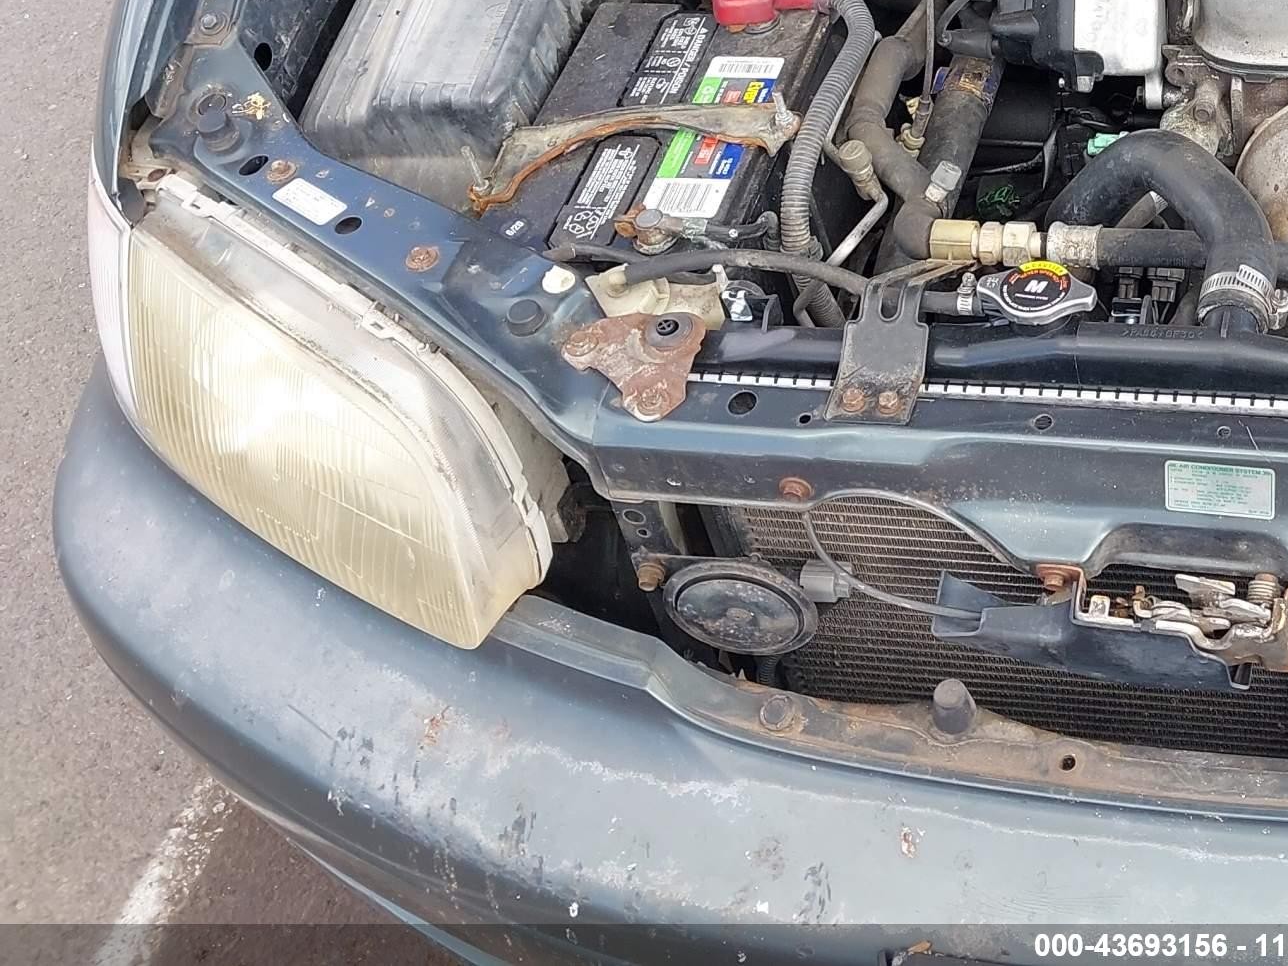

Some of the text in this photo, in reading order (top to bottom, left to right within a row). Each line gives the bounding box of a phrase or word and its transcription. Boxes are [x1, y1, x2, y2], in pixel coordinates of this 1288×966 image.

[687, 33, 706, 61] DANGER
[670, 68, 689, 94] POISON
[1024, 279, 1048, 293] M
